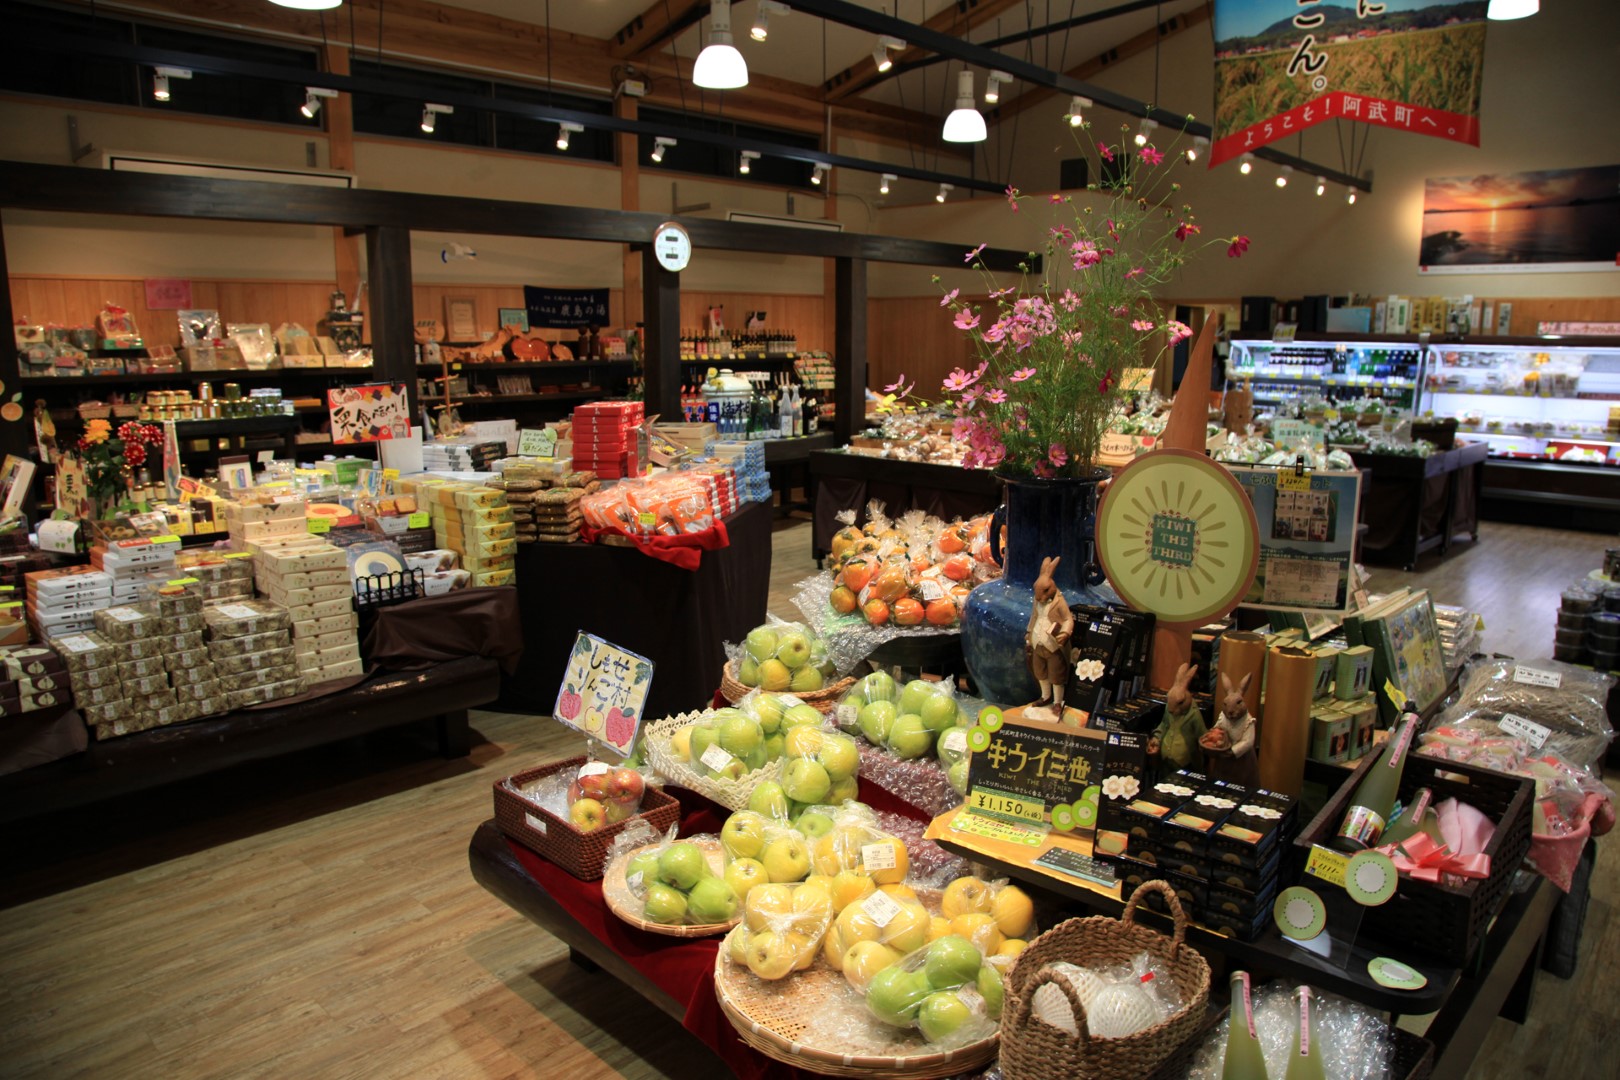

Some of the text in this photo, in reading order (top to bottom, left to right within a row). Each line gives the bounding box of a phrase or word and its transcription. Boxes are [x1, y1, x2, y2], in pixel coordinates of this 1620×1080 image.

[1155, 518, 1193, 533] KIWI
[1160, 532, 1188, 547] THE
[1153, 546, 1193, 561] THIRD
[987, 738, 1092, 785] キウイ三世
[1026, 778, 1040, 786] THE
